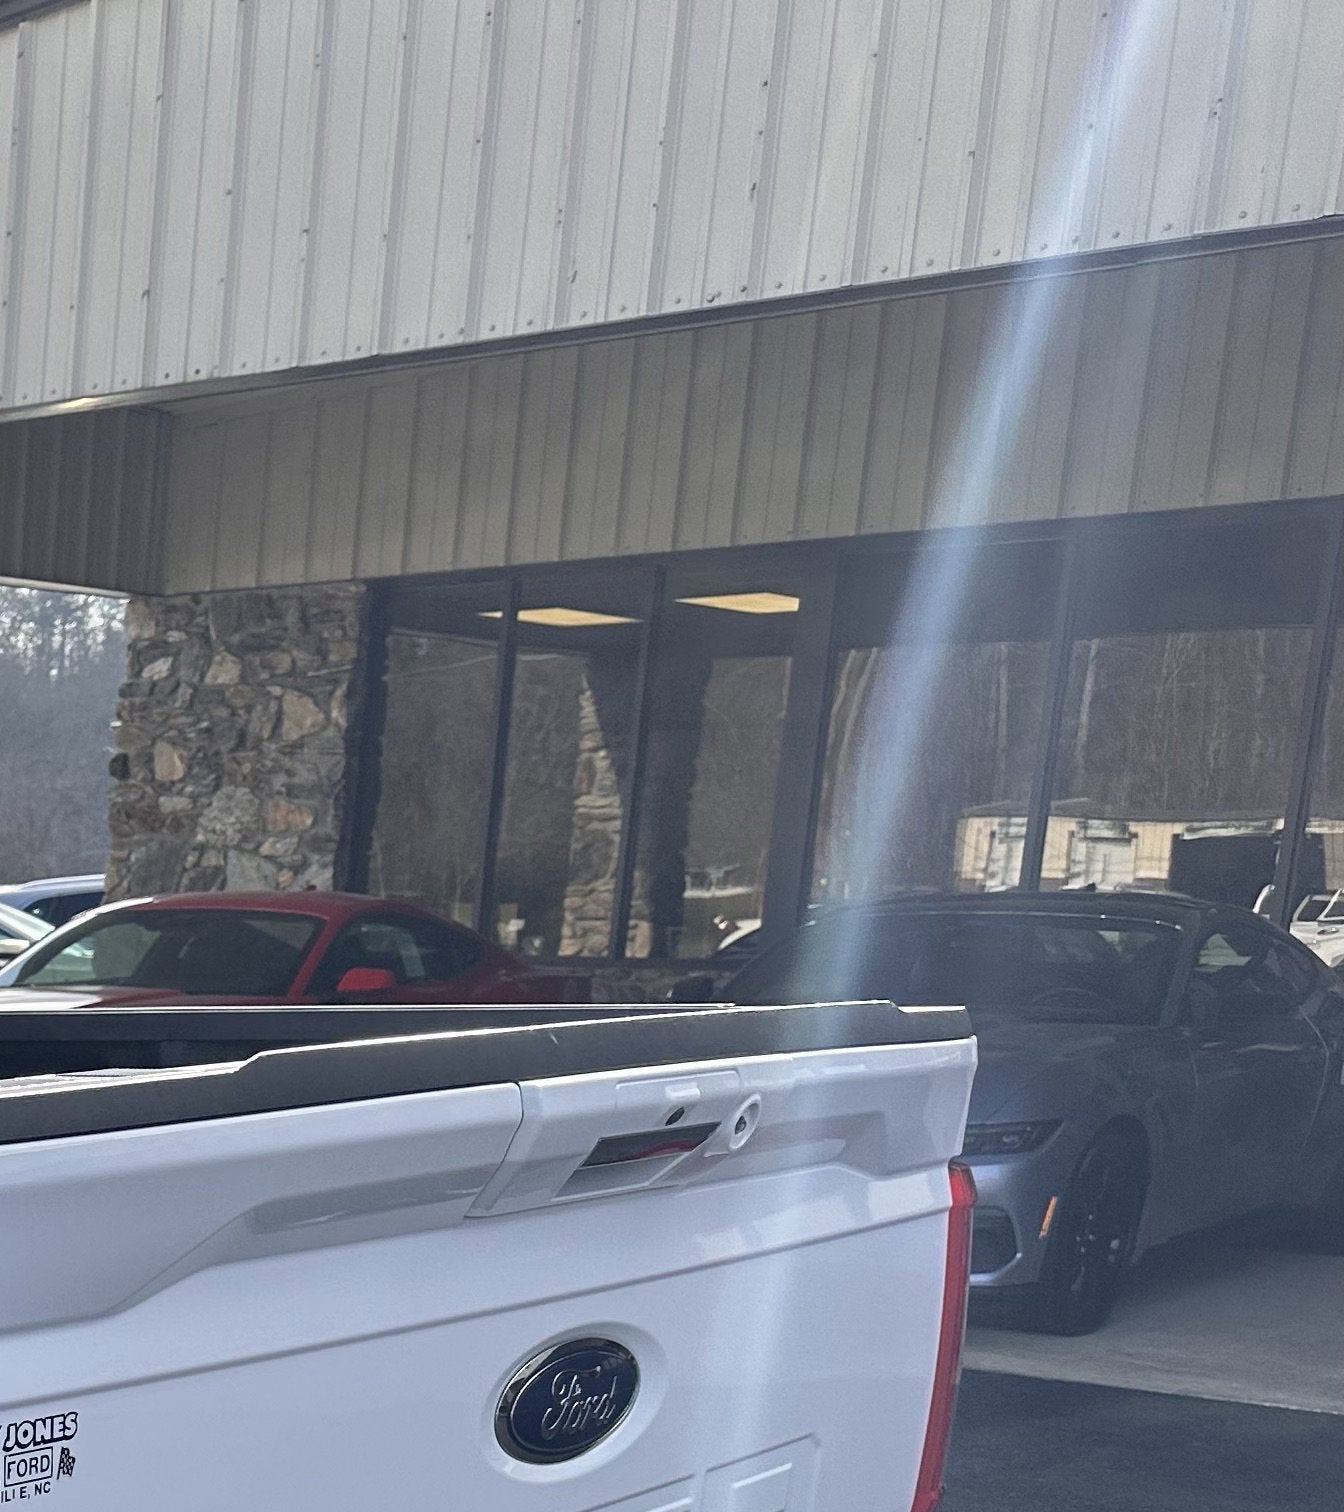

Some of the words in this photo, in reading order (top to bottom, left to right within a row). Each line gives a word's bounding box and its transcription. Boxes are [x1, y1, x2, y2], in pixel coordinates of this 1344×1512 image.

[540, 1365, 618, 1441] Ford
[2, 1411, 78, 1452] JONES
[6, 1454, 51, 1480] FORD
[34, 1482, 52, 1496] NC
